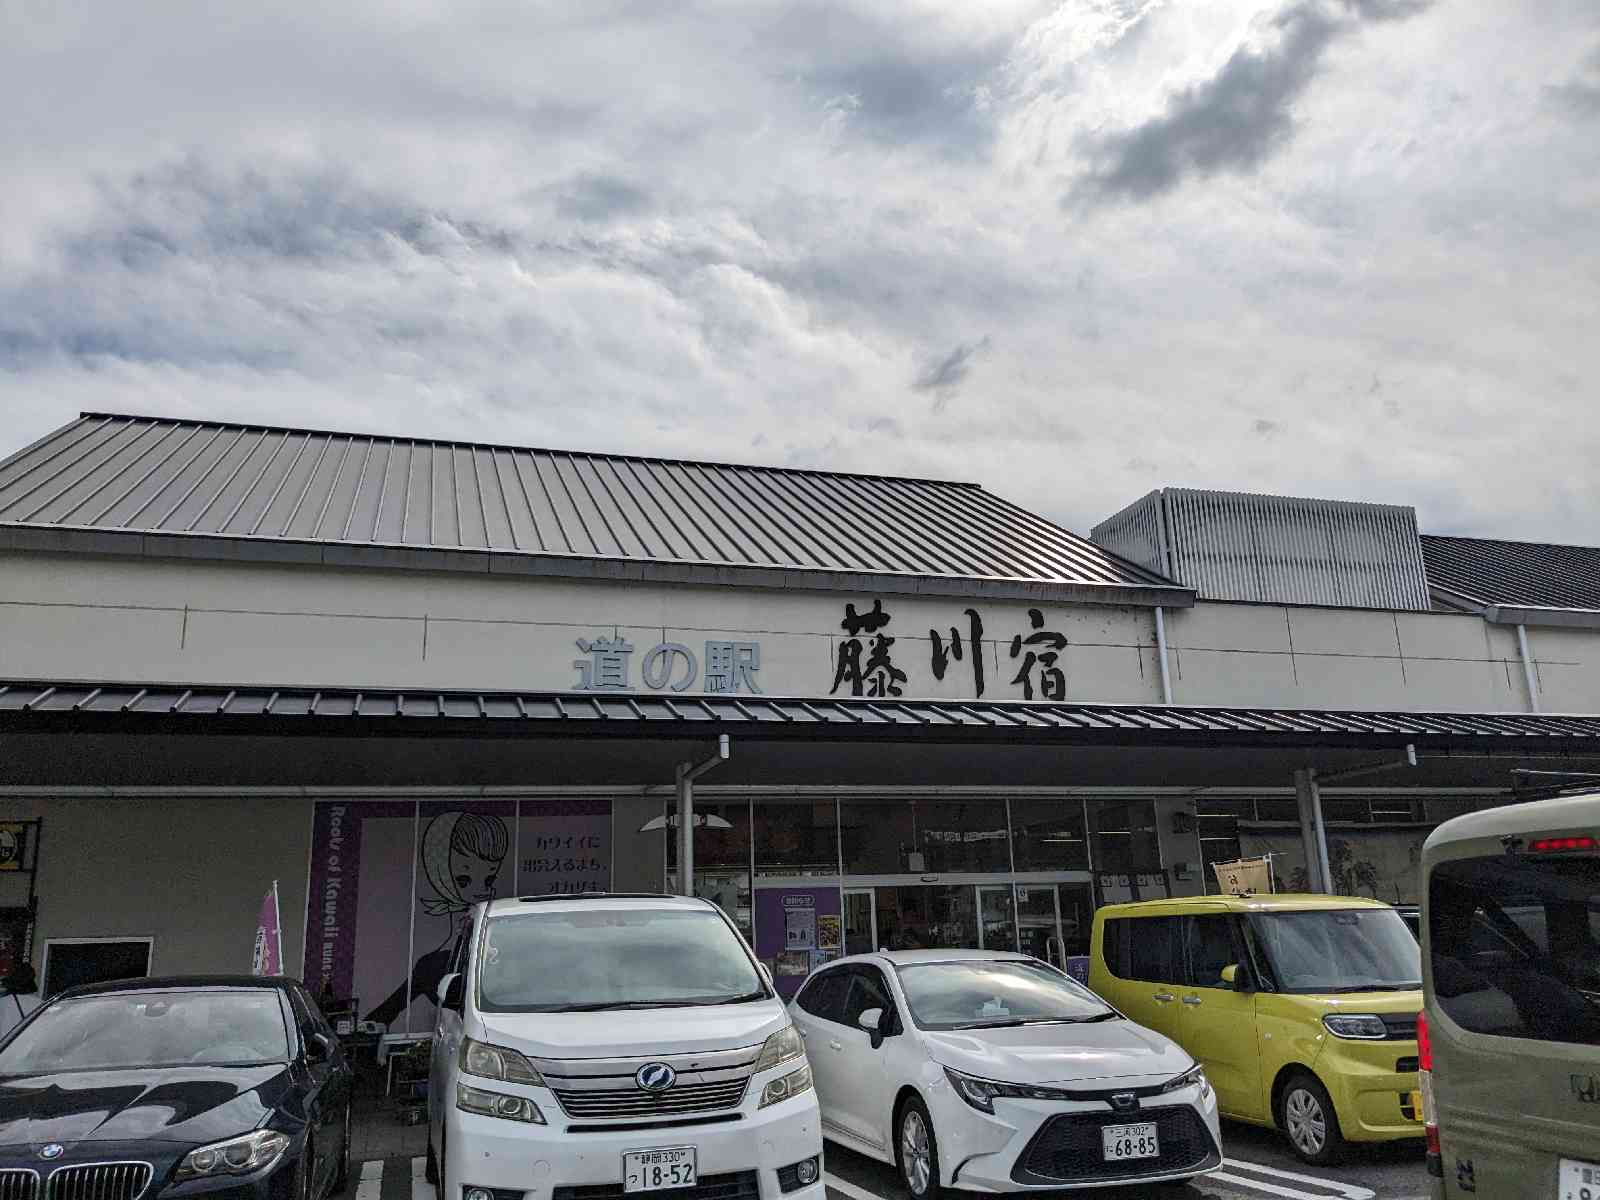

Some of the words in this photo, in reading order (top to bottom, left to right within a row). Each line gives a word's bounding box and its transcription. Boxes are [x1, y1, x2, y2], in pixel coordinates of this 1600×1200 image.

[573, 636, 762, 694] 道の駅
[830, 599, 1068, 702] 藤川宿
[1116, 1137, 1156, 1156] 68-85
[643, 1164, 693, 1188] 18-52
